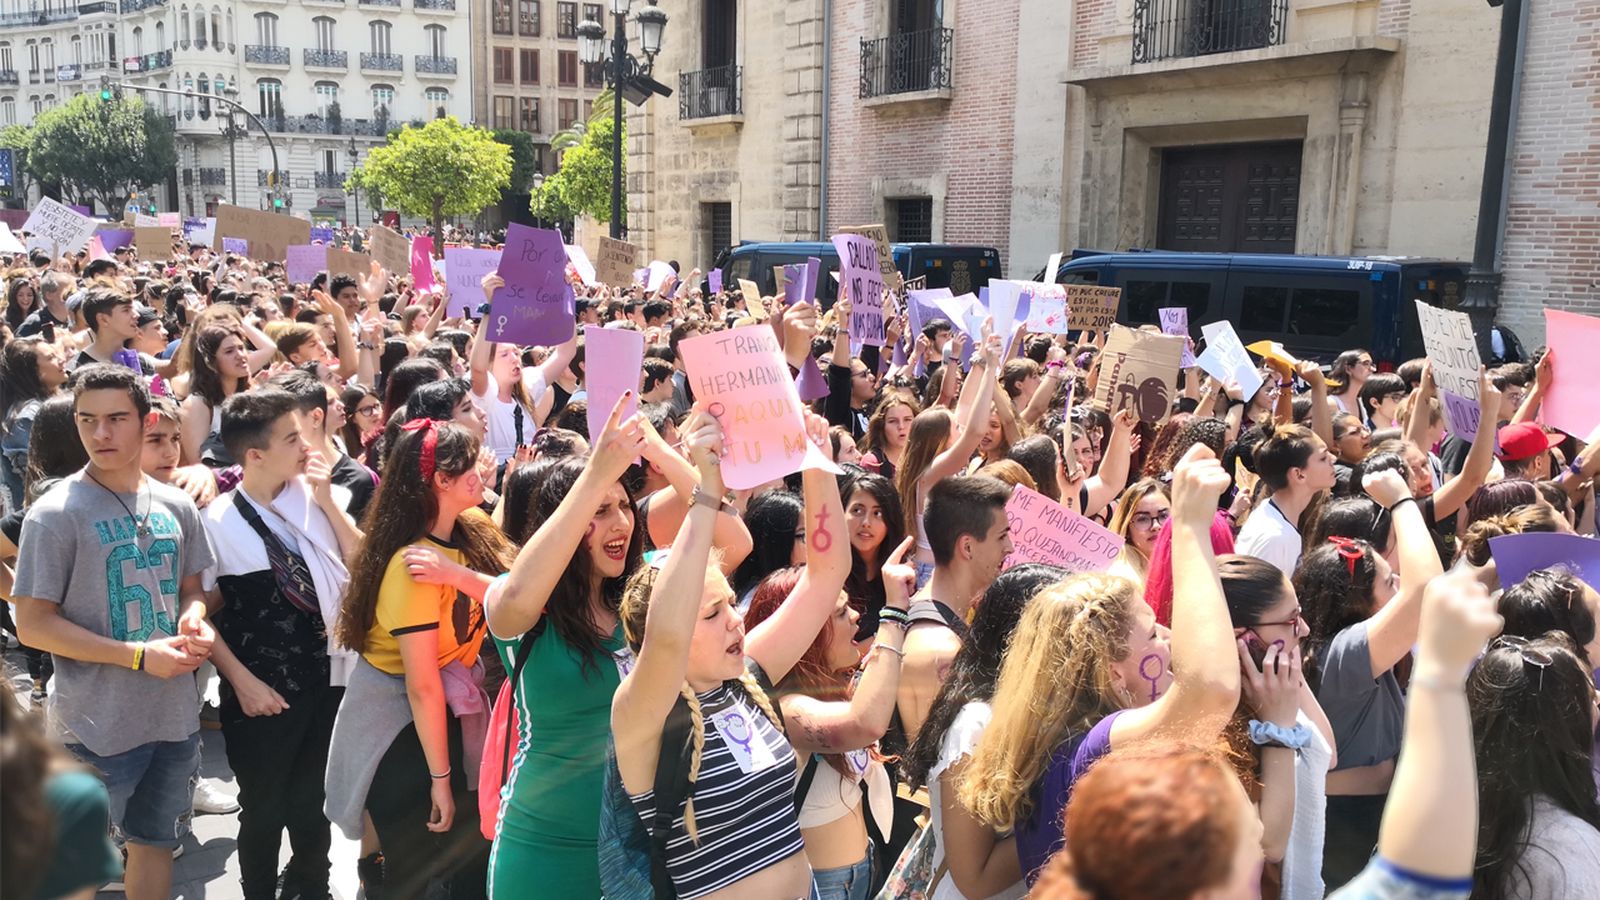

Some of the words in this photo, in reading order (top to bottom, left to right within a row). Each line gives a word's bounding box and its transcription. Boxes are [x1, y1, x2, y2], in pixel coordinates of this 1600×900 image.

[521, 239, 548, 263] Por
[1078, 317, 1089, 326] AL
[1091, 315, 1115, 328] 2018
[727, 440, 762, 467] TU
[1013, 490, 1037, 511] ME
